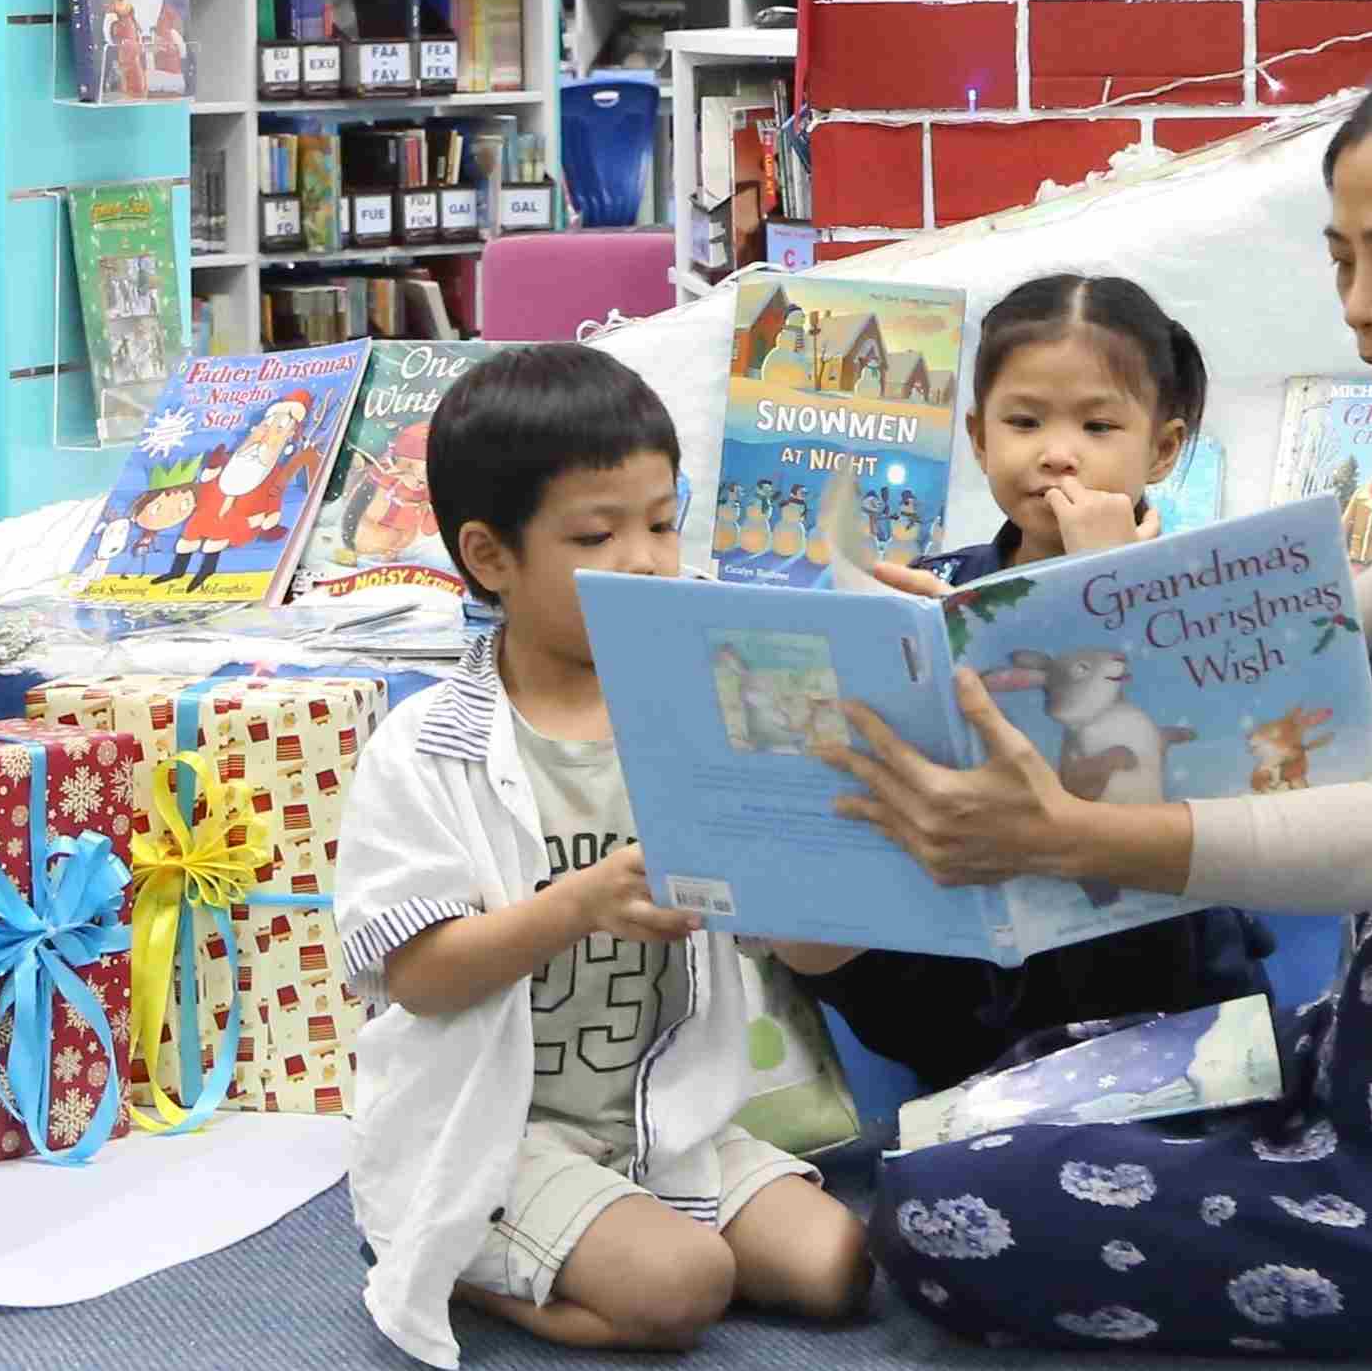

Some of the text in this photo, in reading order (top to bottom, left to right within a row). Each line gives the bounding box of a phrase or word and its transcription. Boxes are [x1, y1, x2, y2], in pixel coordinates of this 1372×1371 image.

[371, 45, 398, 58] FAA
[427, 44, 451, 56] FEA
[427, 66, 452, 77] FEK
[360, 208, 386, 221] FUE
[510, 201, 538, 214] GAL
[783, 248, 796, 268] C
[185, 354, 358, 385] Father Christmas
[400, 346, 469, 380] One
[206, 387, 273, 407] Naughty
[364, 384, 443, 419] Wint
[202, 408, 244, 429] Step
[756, 398, 918, 444] SNOWMEN
[780, 446, 805, 466] AT
[1082, 533, 1311, 630] Grandma's
[1144, 580, 1344, 651] Christmas
[1181, 638, 1286, 689] Wish
